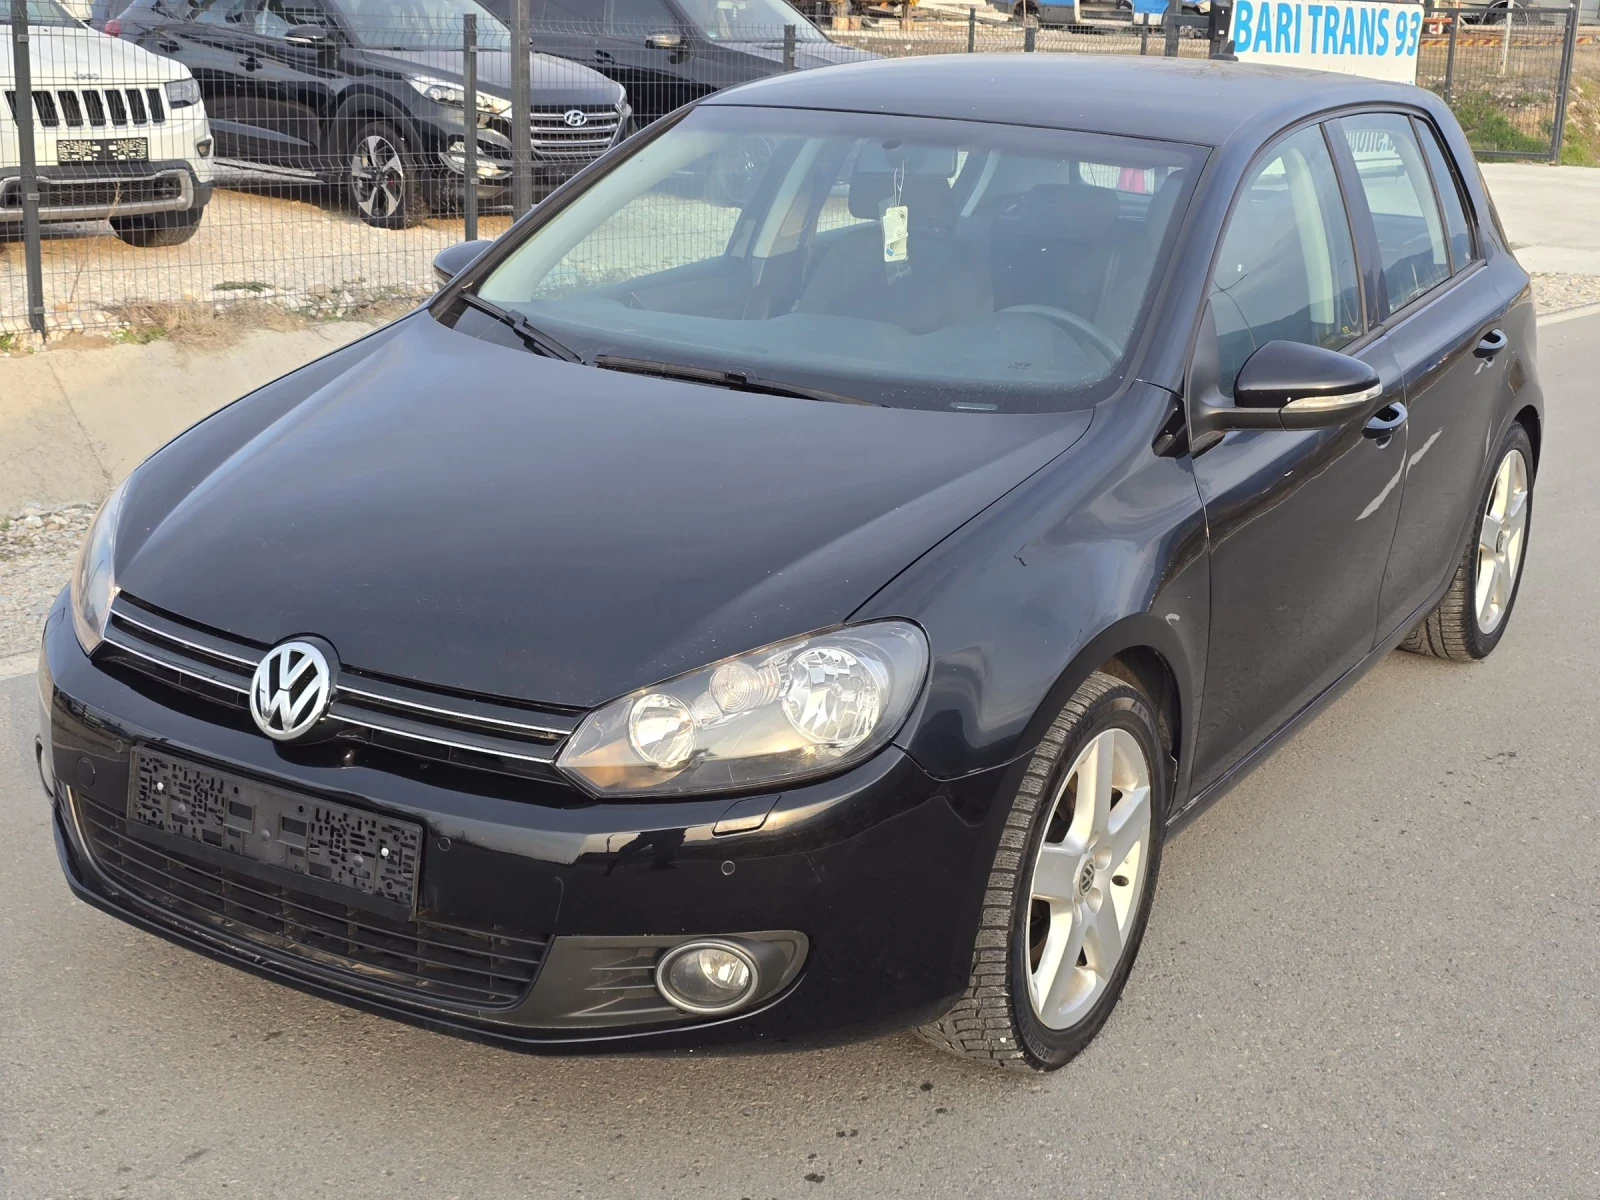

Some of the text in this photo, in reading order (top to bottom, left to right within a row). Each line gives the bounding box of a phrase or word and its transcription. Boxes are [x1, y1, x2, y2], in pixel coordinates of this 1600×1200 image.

[1233, 0, 1421, 57] BARI TRANS 93
